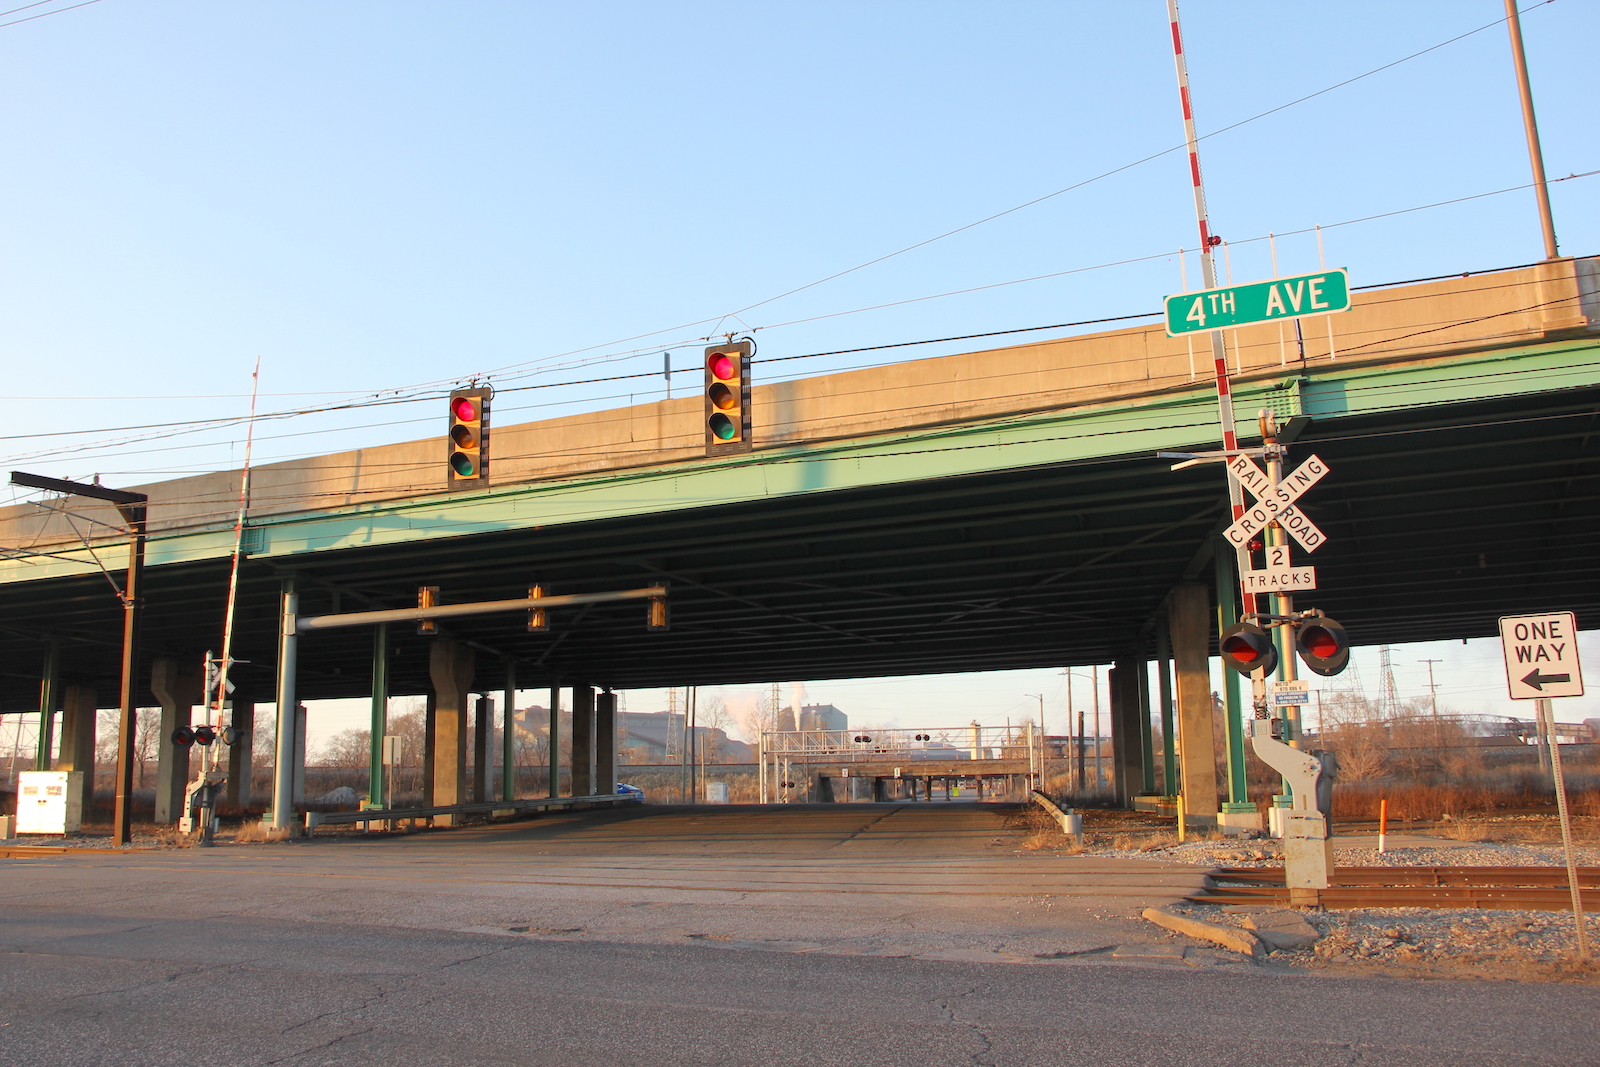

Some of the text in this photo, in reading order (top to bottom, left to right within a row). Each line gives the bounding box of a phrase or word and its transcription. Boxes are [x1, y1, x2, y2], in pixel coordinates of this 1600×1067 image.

[1185, 276, 1329, 327] 4TH AVE
[1229, 460, 1322, 543] CROSSING
[1271, 549, 1284, 566] 2
[1248, 572, 1311, 587] TRACKS
[1514, 620, 1563, 641] ONE
[1514, 642, 1566, 664] WAY
